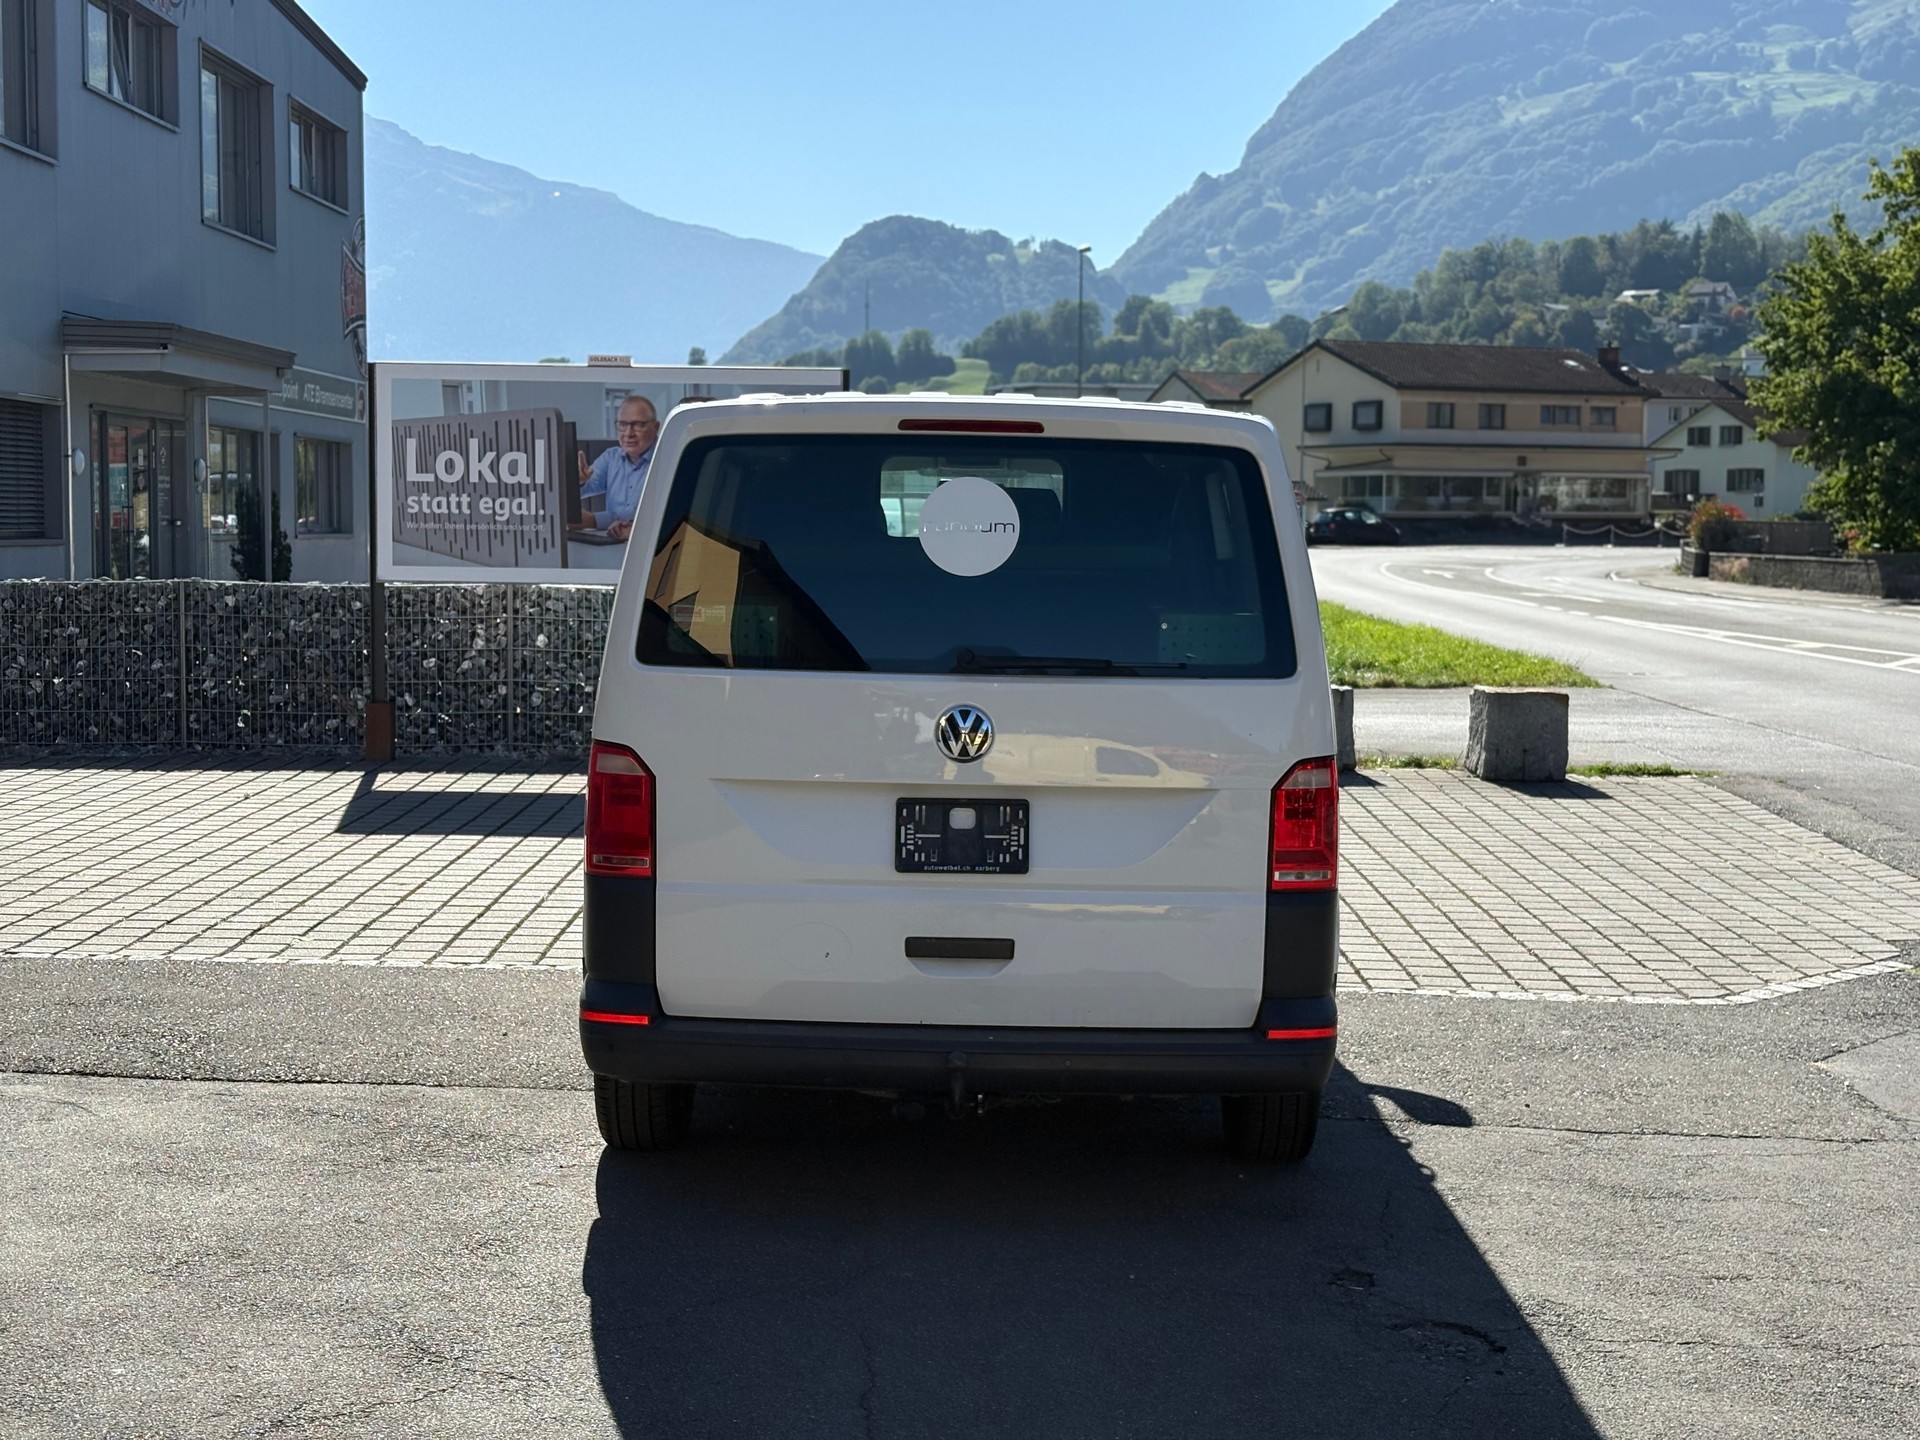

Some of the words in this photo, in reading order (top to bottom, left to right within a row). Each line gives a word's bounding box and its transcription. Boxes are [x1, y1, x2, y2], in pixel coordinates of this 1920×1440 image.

[406, 438, 545, 484] Lokal
[407, 493, 471, 514] statt
[479, 491, 545, 521] egal.
[406, 521, 419, 529] Wir
[420, 521, 443, 530] helfen
[444, 522, 465, 530] Ihnen
[466, 522, 502, 531] persönlich
